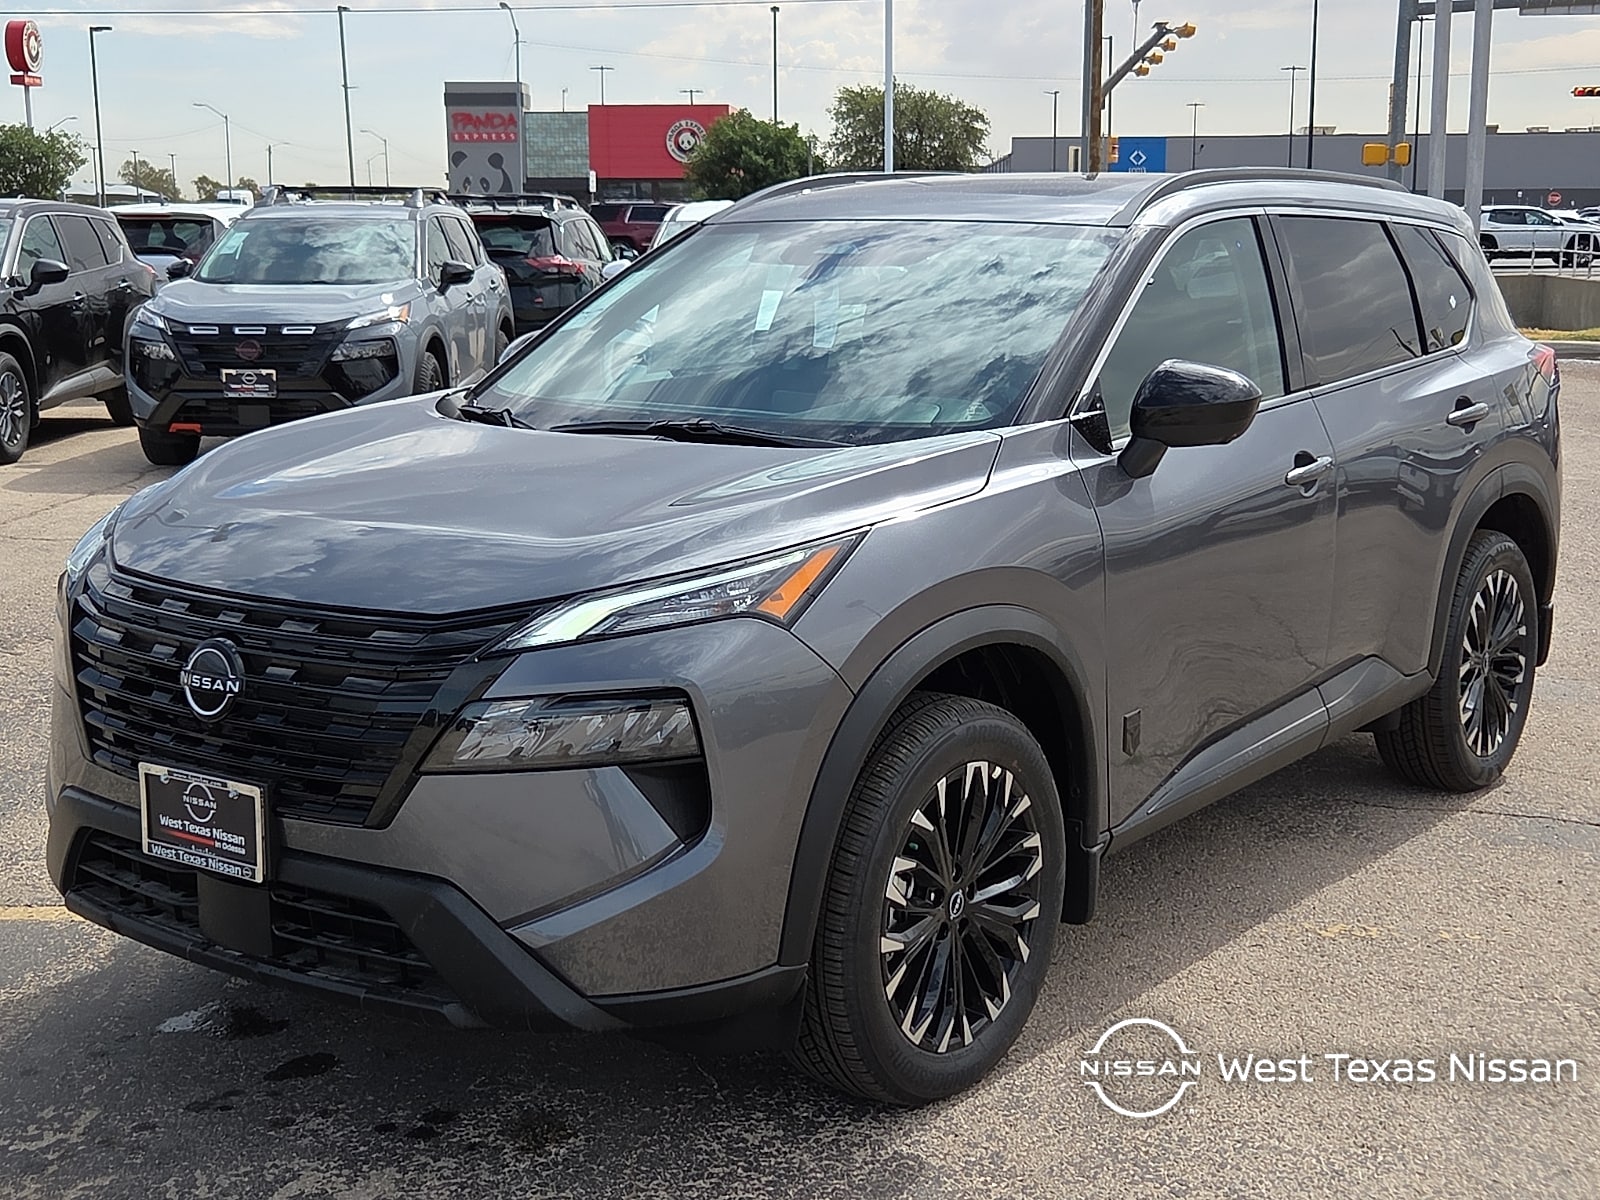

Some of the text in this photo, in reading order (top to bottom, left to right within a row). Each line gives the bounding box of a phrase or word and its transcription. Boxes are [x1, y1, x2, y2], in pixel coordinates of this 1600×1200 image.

[452, 112, 517, 131] PANDA
[668, 121, 707, 142] PANDA EXPRES
[180, 671, 240, 693] NISSAN
[183, 794, 217, 809] NISSAN
[159, 814, 245, 846] West Texas Nissan
[222, 842, 246, 855] Odessa
[151, 844, 177, 859] West
[177, 850, 206, 867] Texas
[208, 857, 242, 876] Nissan
